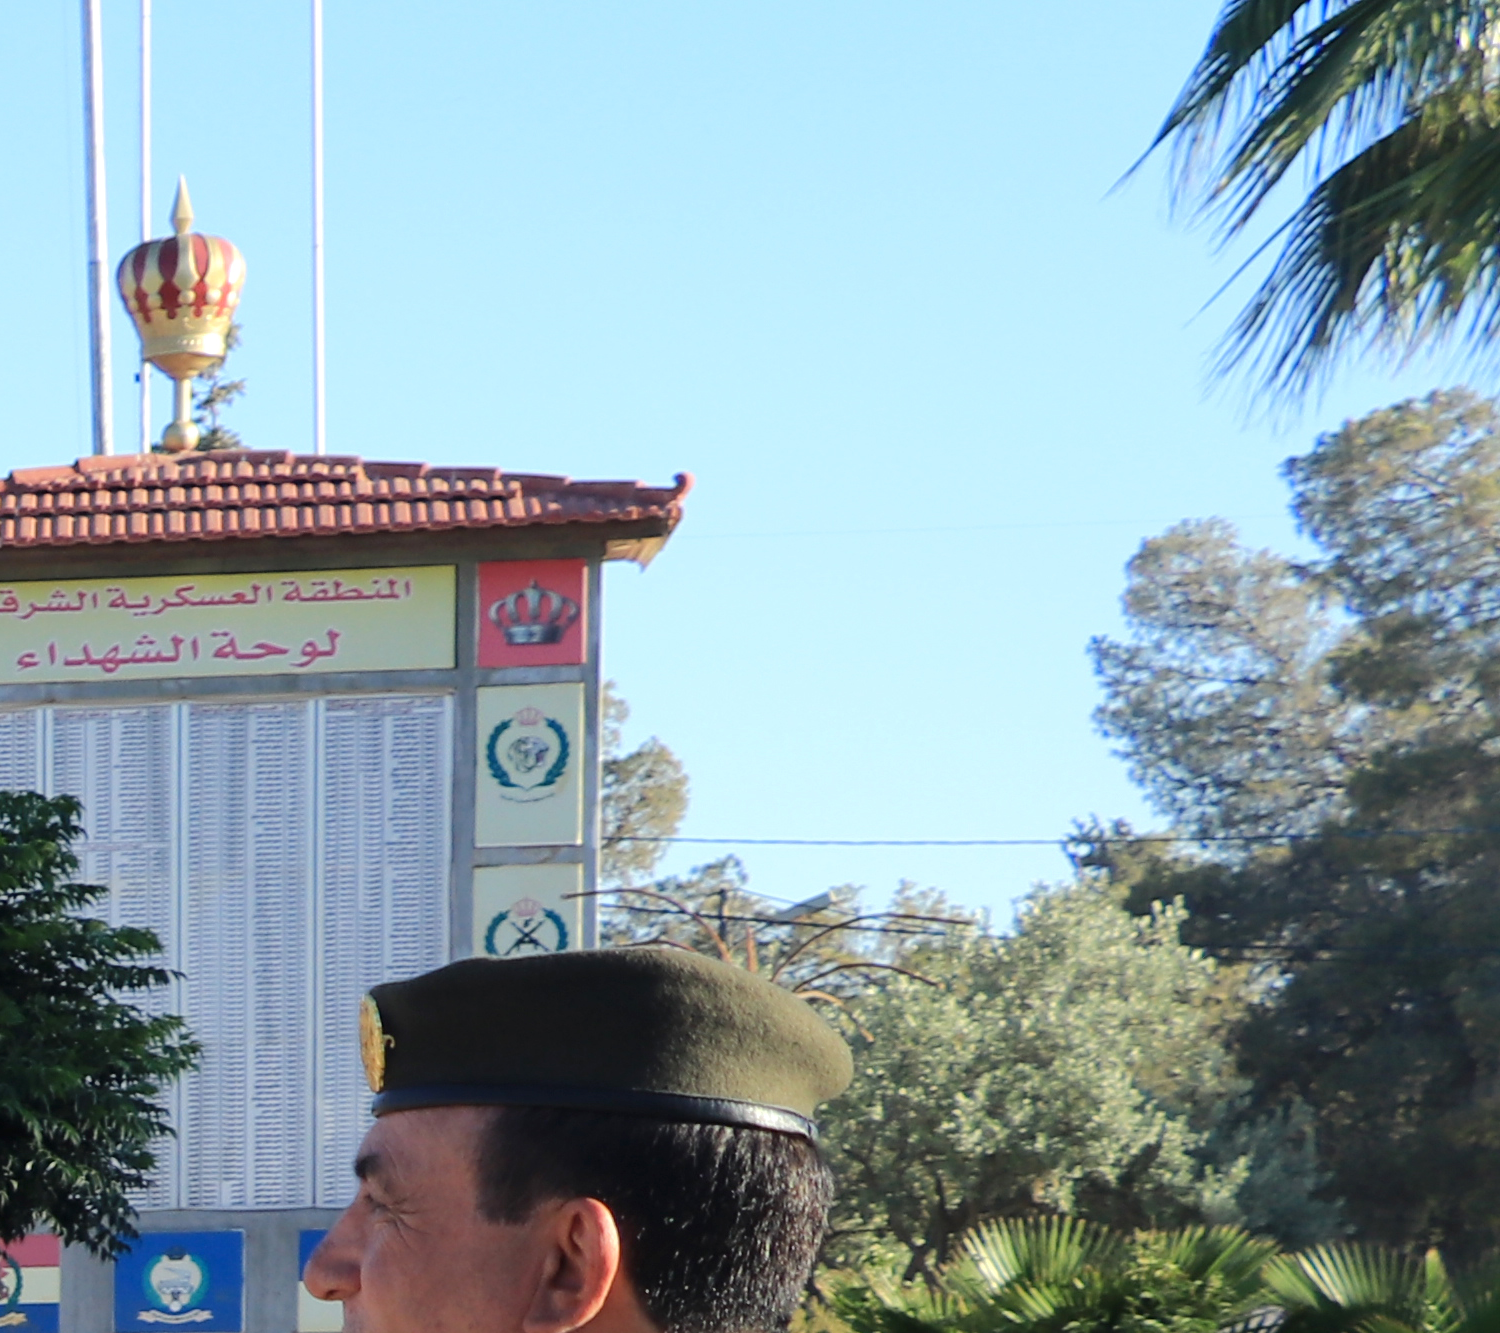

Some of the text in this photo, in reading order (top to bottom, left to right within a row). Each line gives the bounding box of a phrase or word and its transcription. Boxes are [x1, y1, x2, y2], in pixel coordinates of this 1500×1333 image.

[107, 585, 272, 617] العسكرية
[284, 578, 411, 602] المنطقة
[15, 628, 341, 673] لوحة الشهداء
